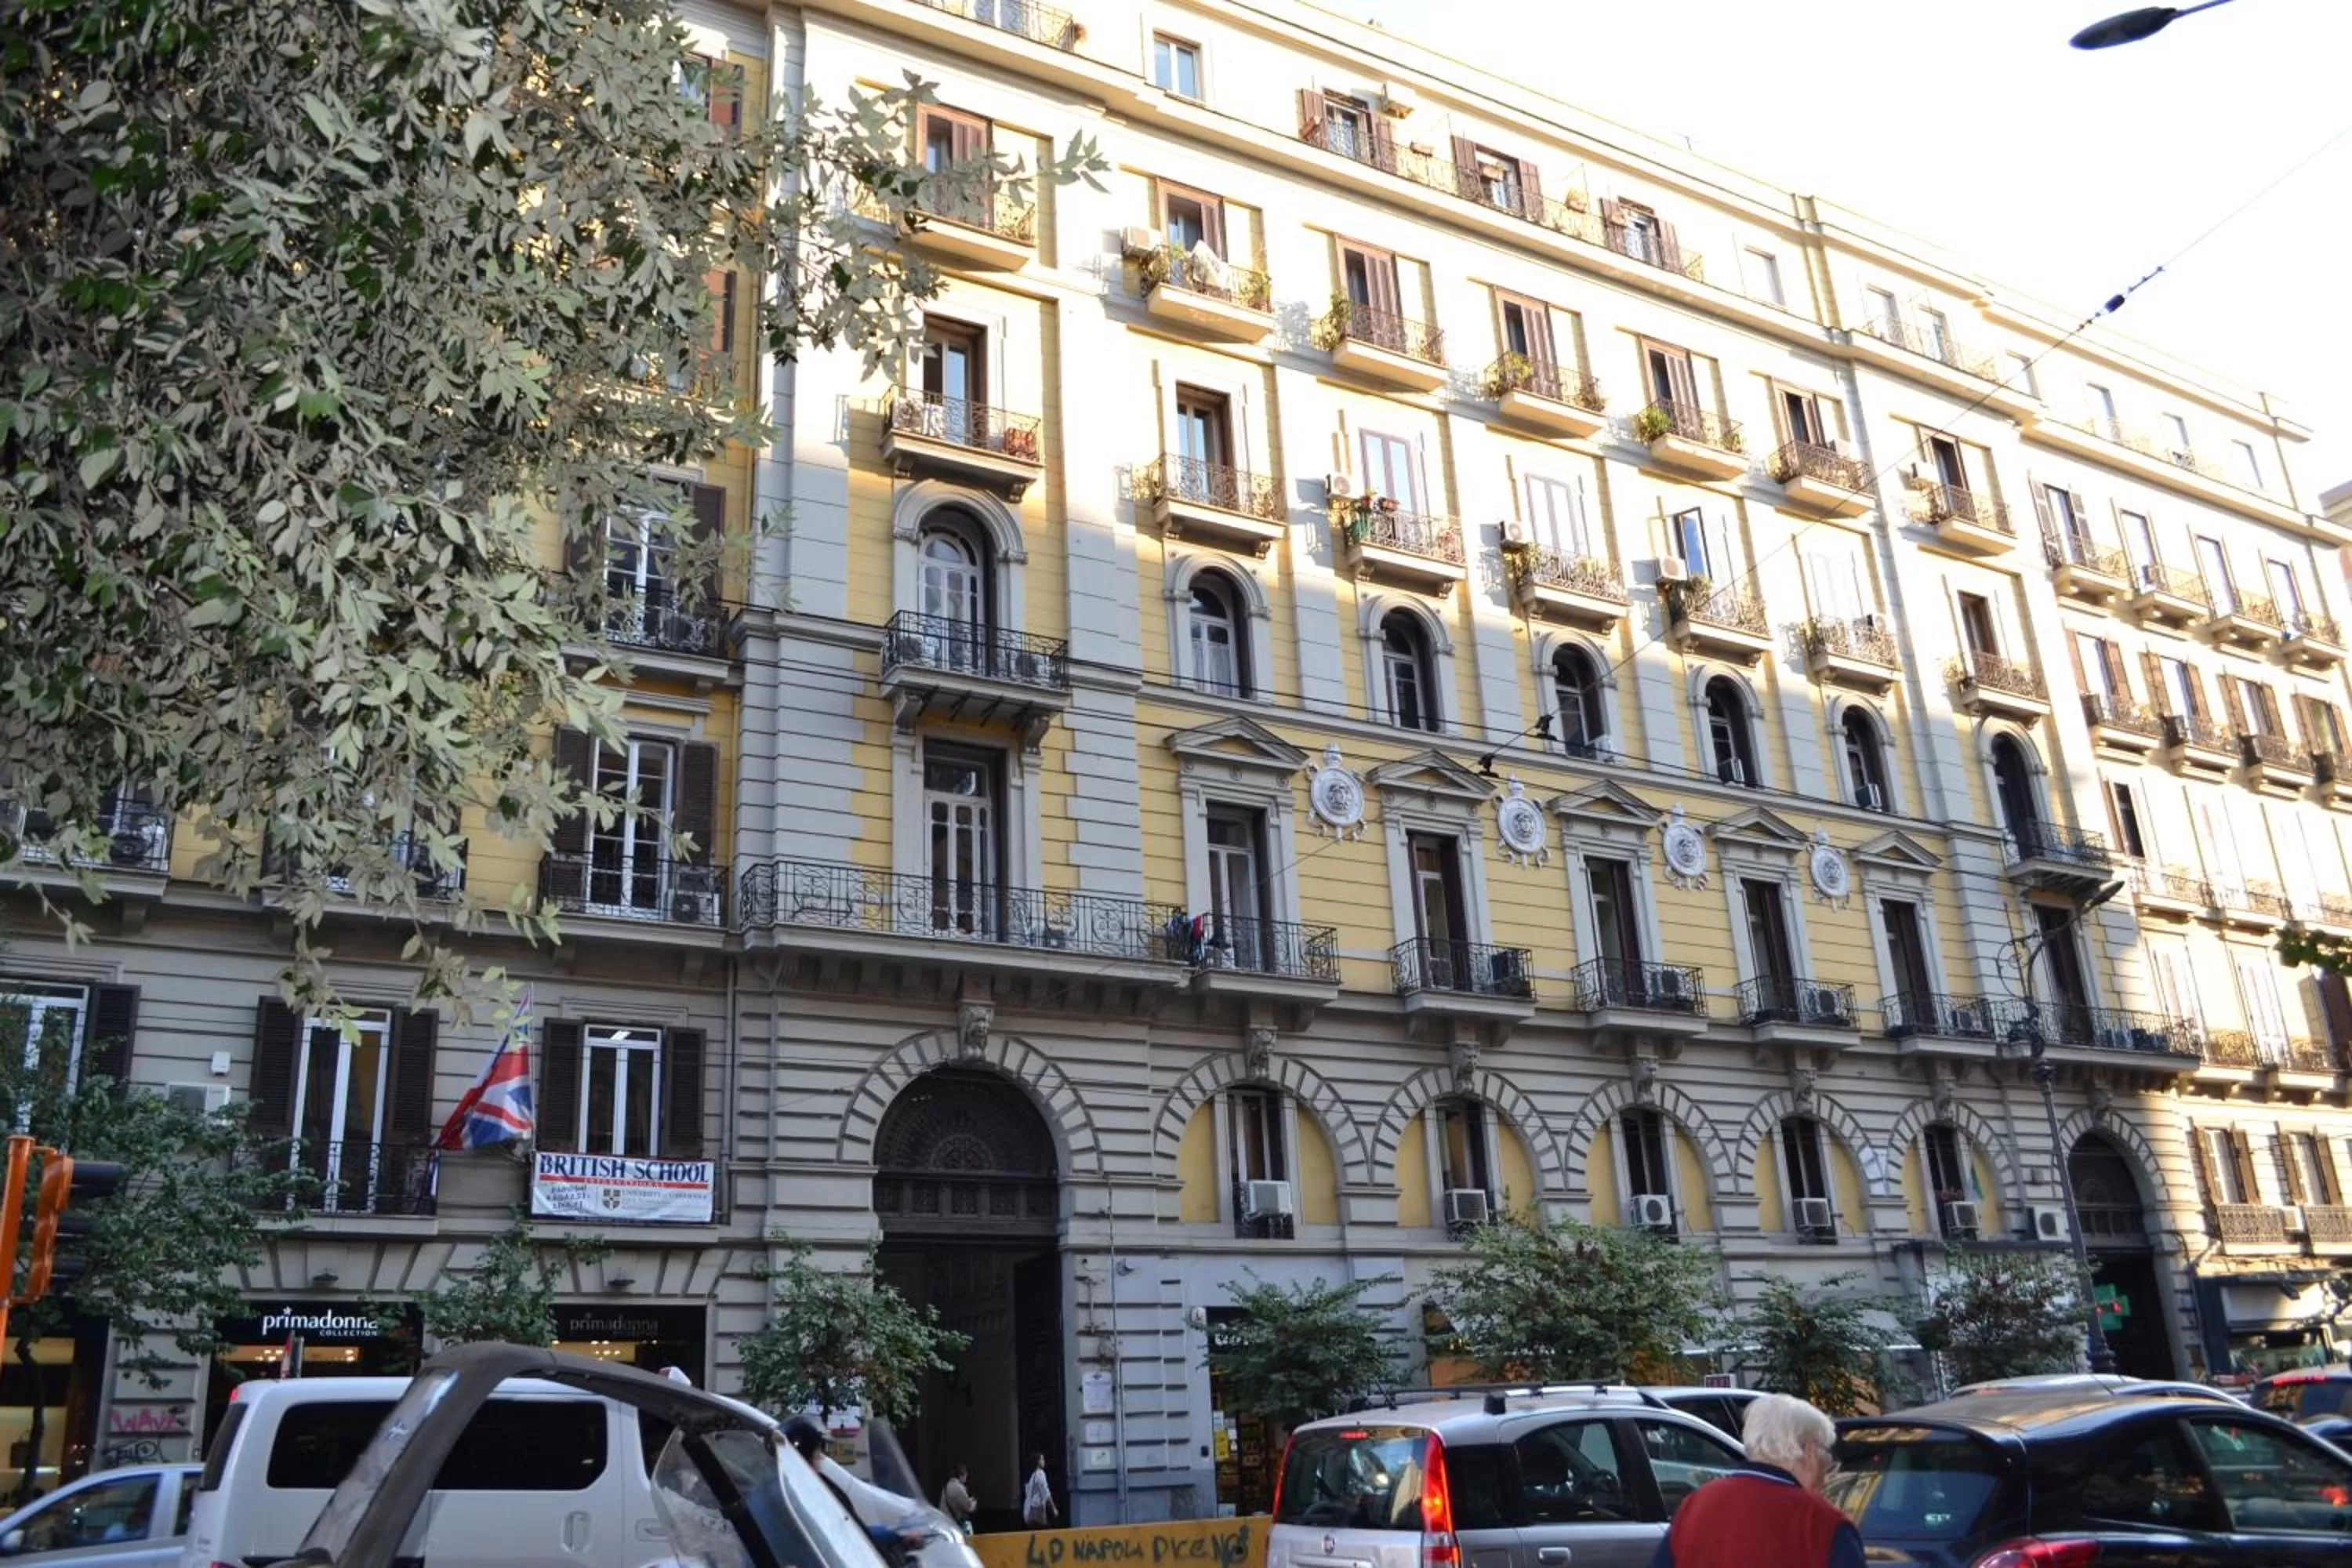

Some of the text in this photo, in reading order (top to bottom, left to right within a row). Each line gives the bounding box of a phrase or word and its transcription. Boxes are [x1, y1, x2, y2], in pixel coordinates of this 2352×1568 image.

[539, 1154, 709, 1183] BRITISH SCHOOL
[263, 1305, 378, 1336] primadonna
[570, 1312, 659, 1332] primadonna
